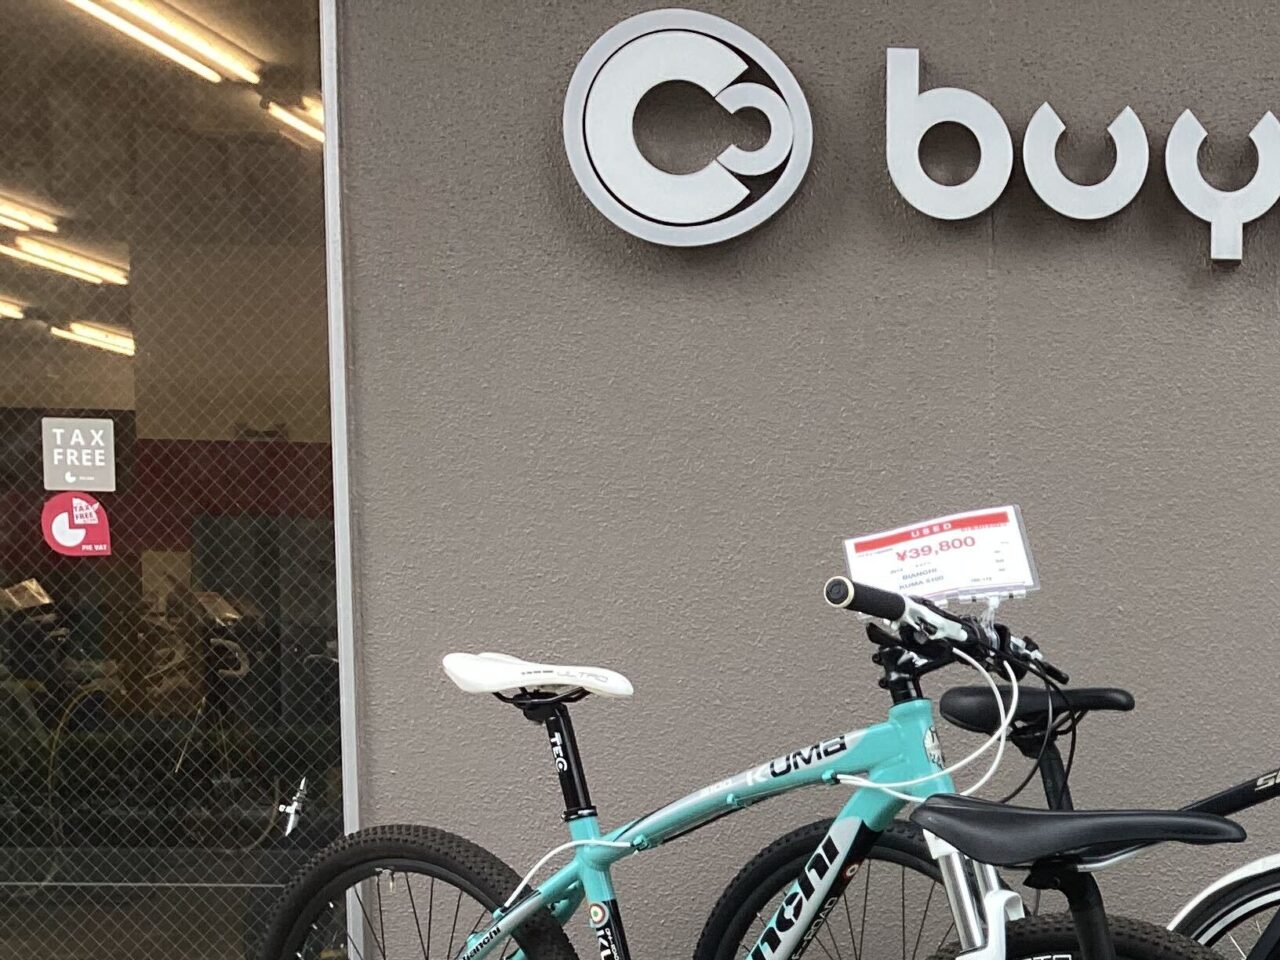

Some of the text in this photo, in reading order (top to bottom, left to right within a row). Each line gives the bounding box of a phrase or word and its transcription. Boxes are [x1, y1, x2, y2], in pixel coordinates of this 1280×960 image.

[52, 428, 105, 446] TAX
[53, 448, 106, 466] FREE
[74, 512, 94, 520] FREE
[911, 522, 953, 538] USED
[896, 536, 976, 562] ¥39,800
